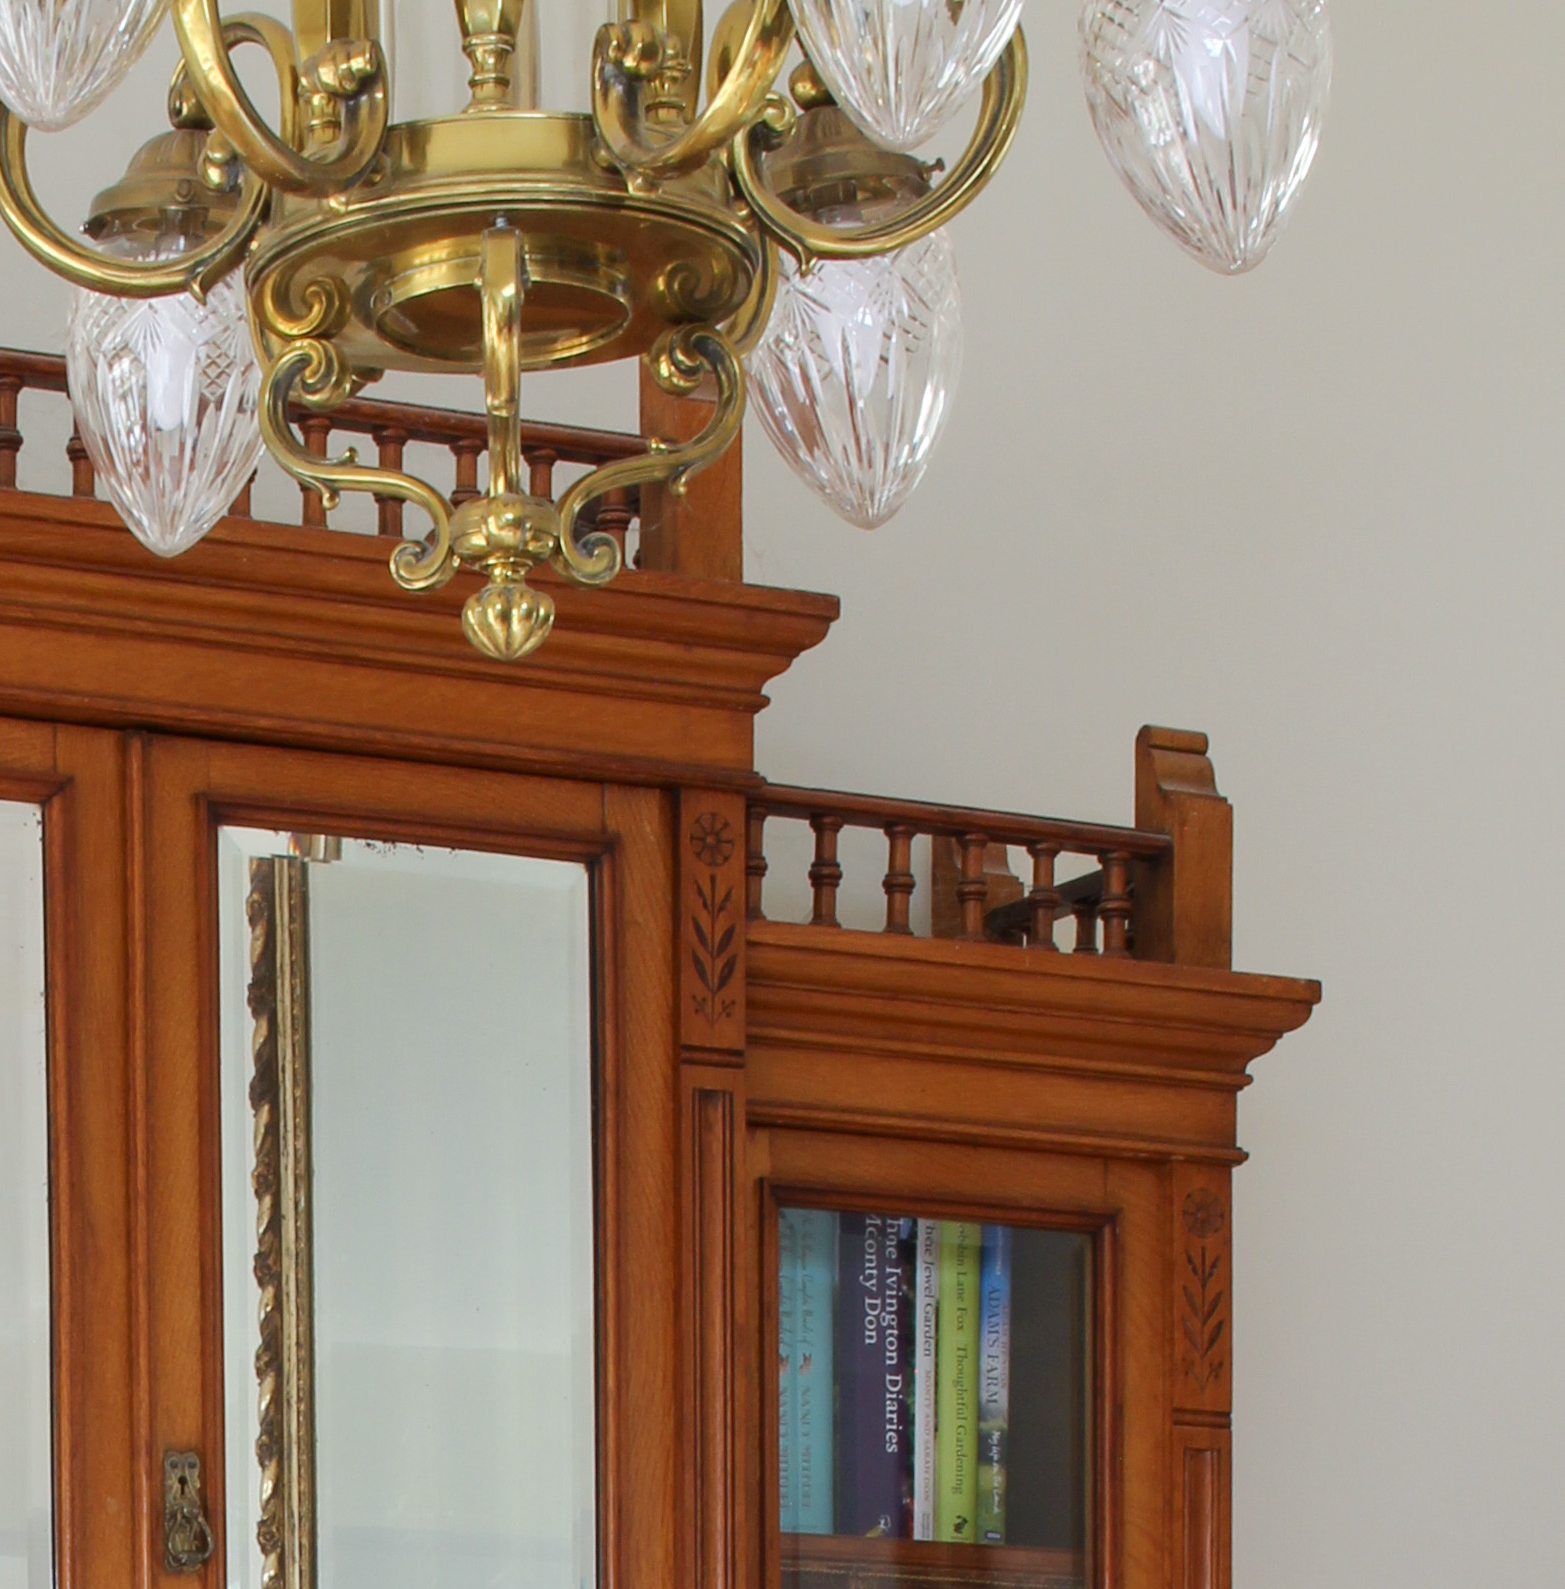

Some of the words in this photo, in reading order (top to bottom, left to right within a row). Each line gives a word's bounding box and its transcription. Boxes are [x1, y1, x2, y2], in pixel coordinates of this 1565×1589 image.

[957, 1271, 967, 1302] Lane
[864, 1297, 881, 1345] Don
[880, 1266, 902, 1366] Ivington
[924, 1303, 932, 1357] Garden
[956, 1307, 967, 1331] Fox
[954, 1344, 968, 1421] Thoughtful
[986, 1353, 1000, 1405] FARM
[885, 1374, 903, 1453] Diaries
[952, 1424, 967, 1495] Gardening
